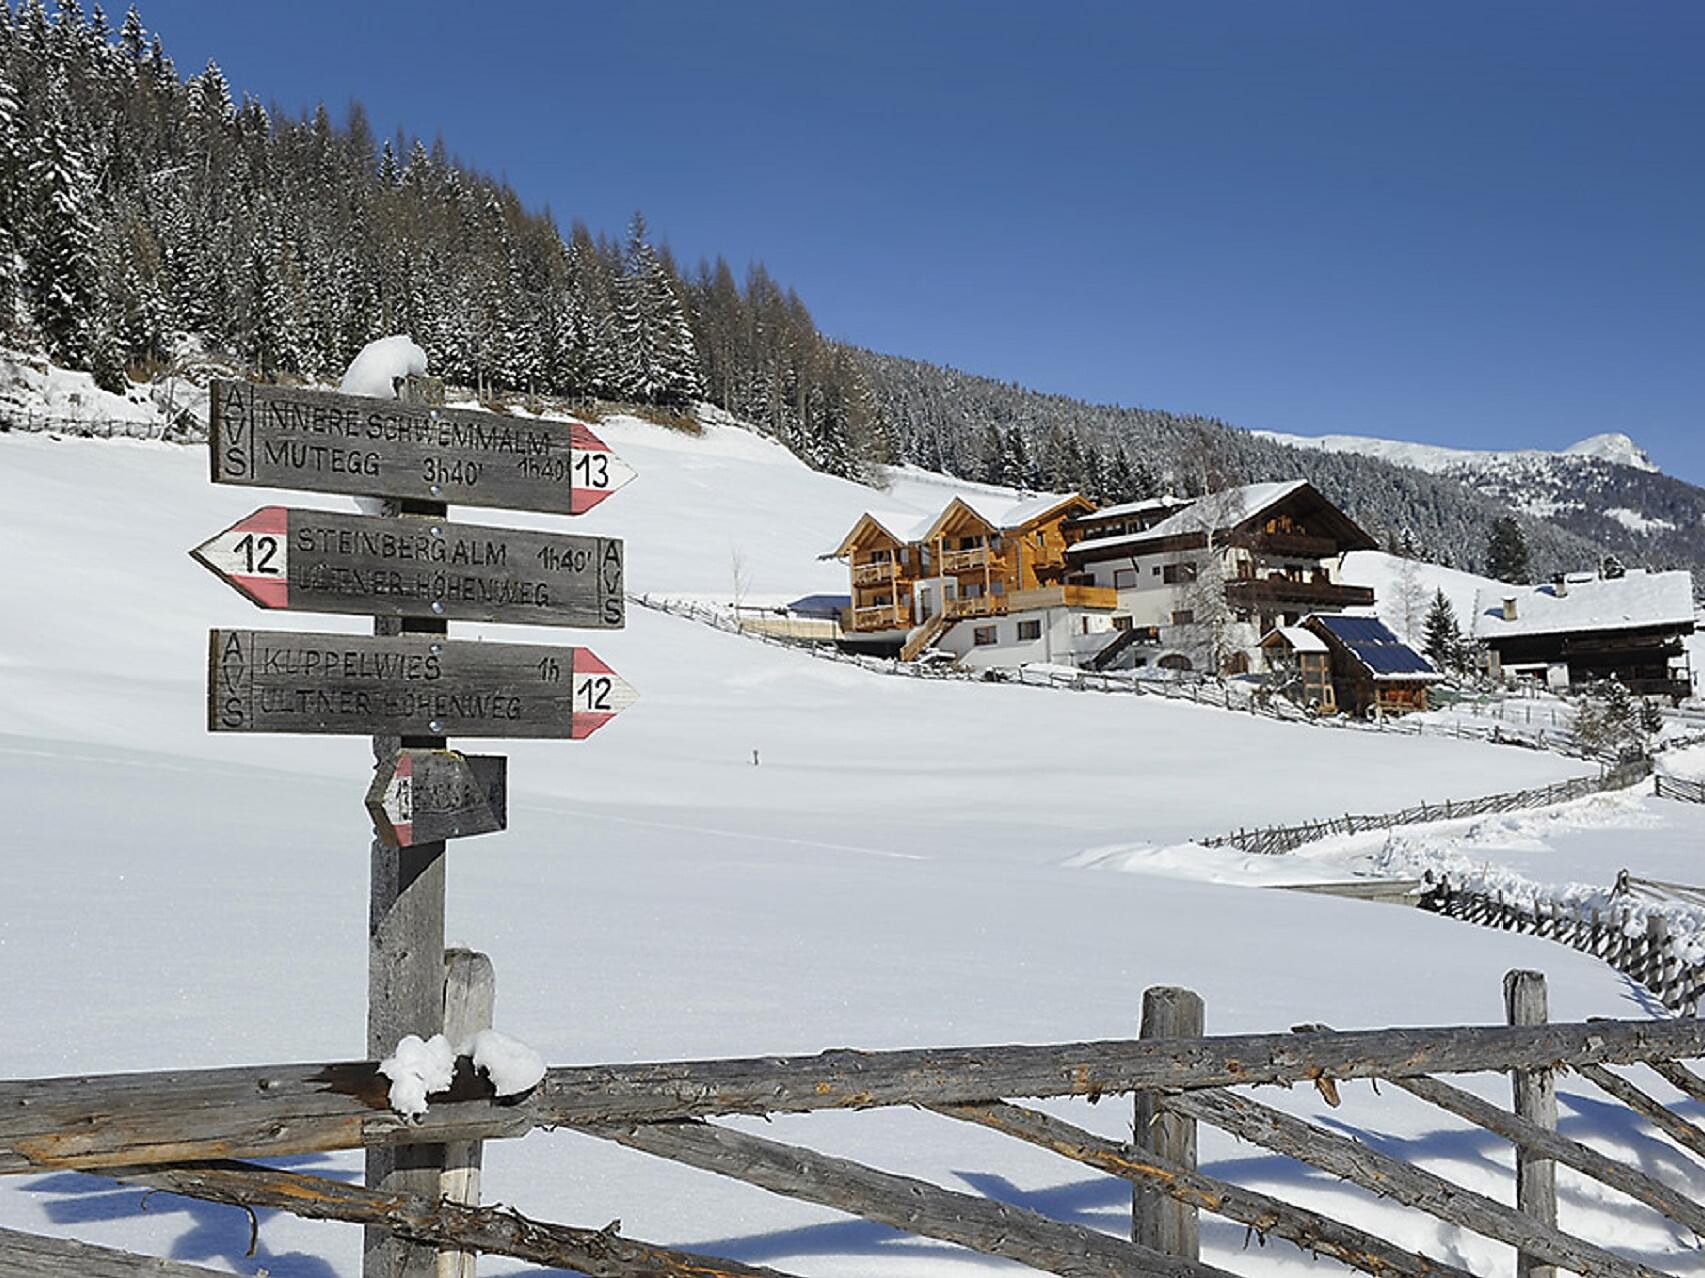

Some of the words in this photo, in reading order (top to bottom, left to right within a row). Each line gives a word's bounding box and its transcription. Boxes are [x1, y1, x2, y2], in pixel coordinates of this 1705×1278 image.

[261, 400, 360, 438] INNERE
[366, 413, 550, 456] SCHWEMMALM
[264, 440, 381, 476] MUTEGG
[423, 457, 483, 486] 3h40'
[575, 453, 610, 489] 13
[233, 533, 280, 574] 12
[416, 569, 550, 607] HÖHENWEG
[263, 646, 442, 680] KUPPELWIES
[538, 656, 561, 684] 1h
[577, 676, 613, 711] 12
